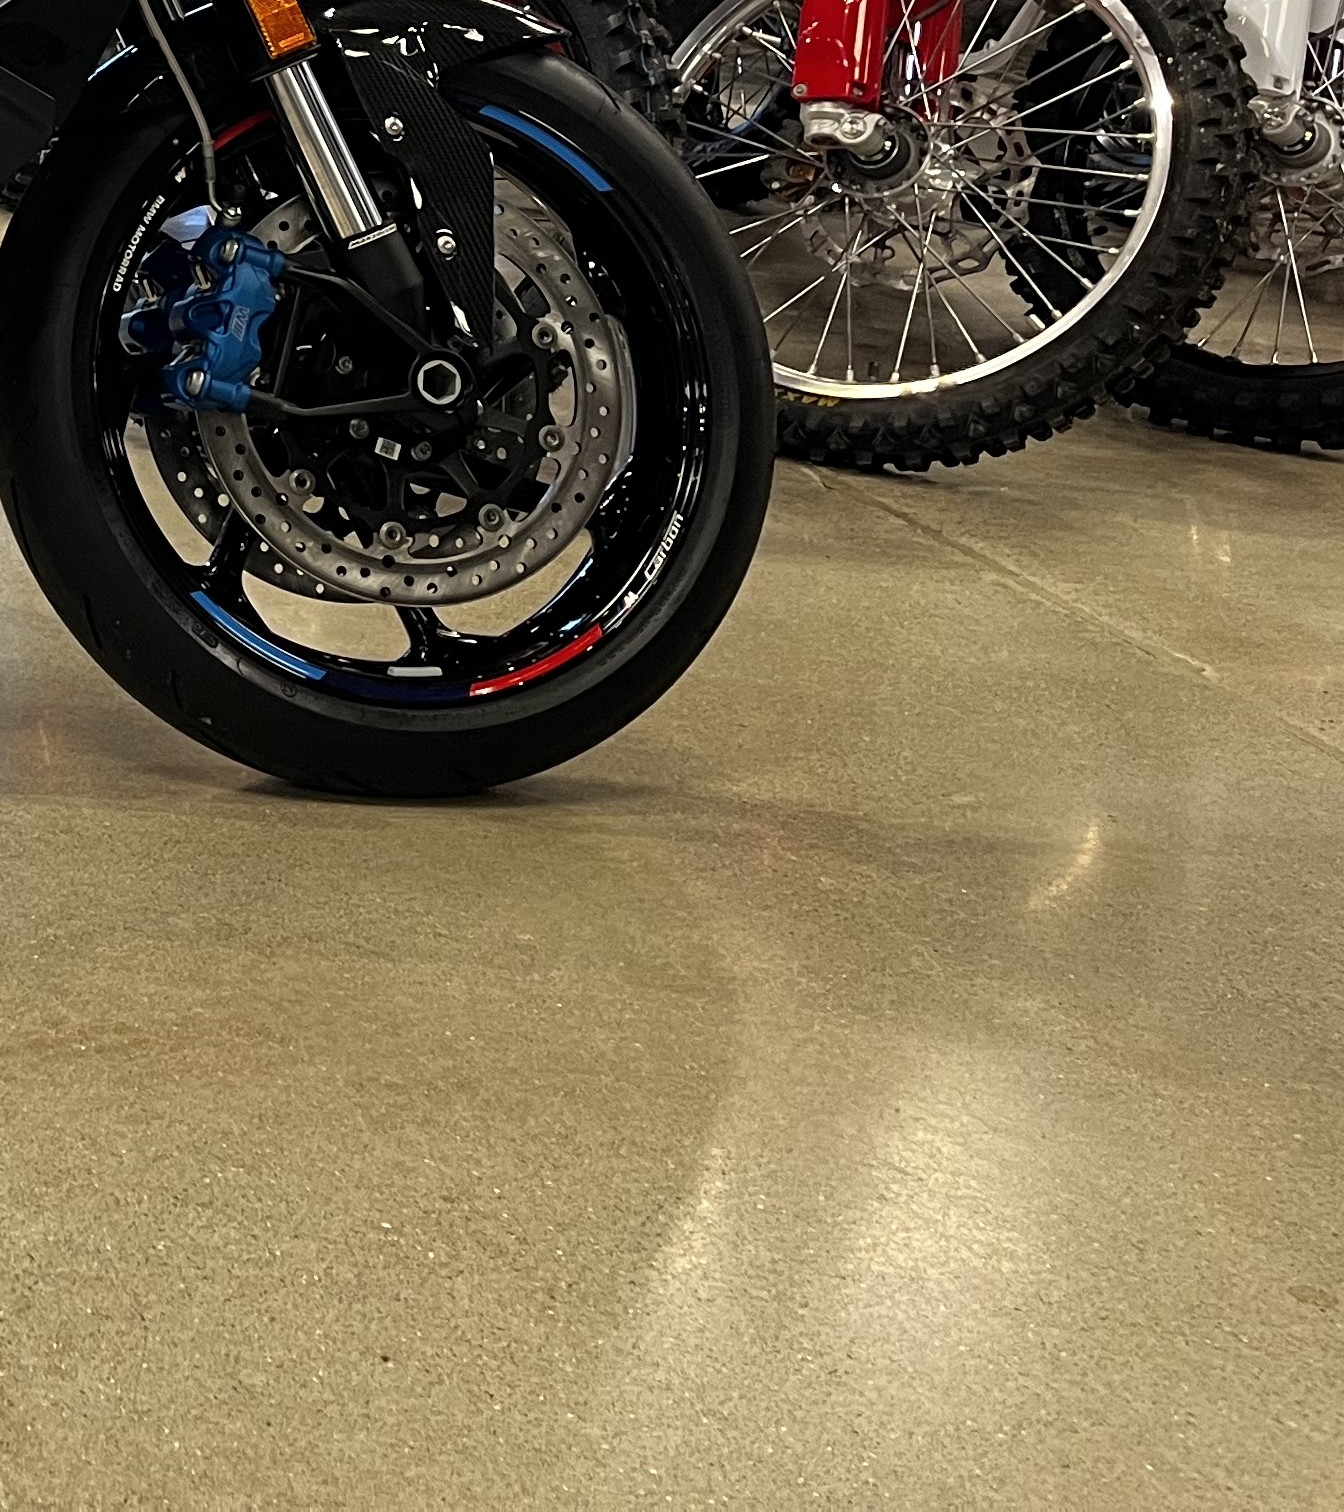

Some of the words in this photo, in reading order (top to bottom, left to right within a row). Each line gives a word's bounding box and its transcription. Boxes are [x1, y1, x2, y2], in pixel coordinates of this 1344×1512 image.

[143, 194, 166, 225] BMW
[112, 224, 146, 293] MOTORRAD
[644, 510, 684, 581] Carbon
